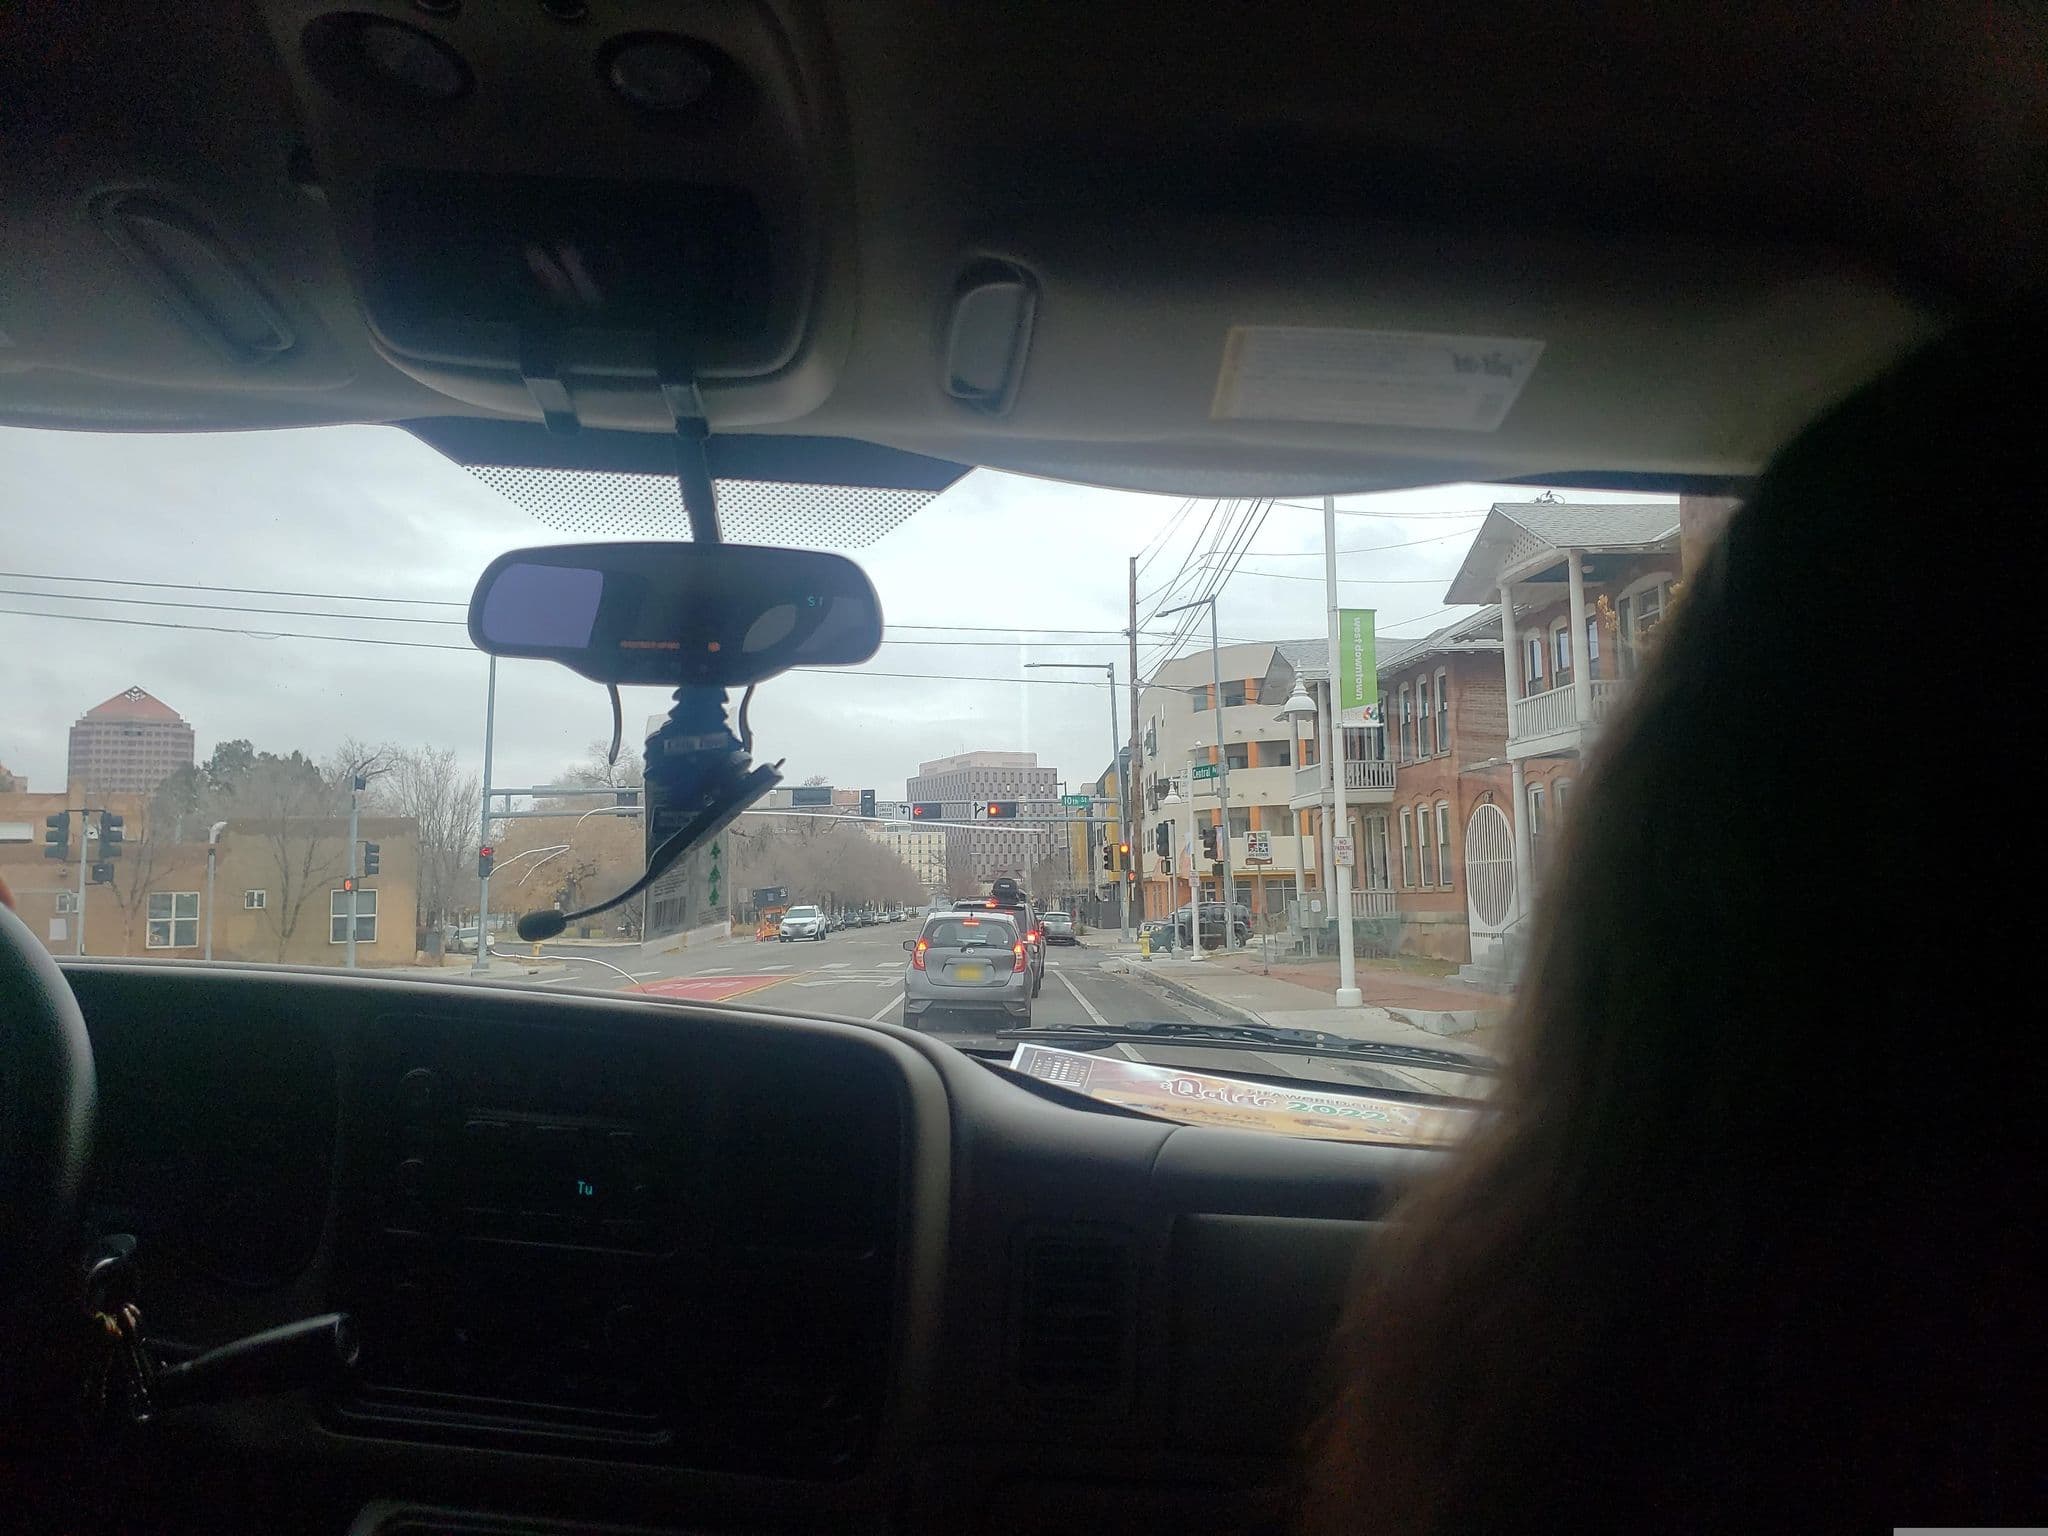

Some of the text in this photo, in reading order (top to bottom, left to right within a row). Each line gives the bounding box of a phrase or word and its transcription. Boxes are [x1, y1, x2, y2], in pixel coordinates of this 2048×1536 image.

[1193, 767, 1211, 779] Central
[1063, 796, 1079, 806] 10th
[1287, 1100, 1390, 1122] 2022
